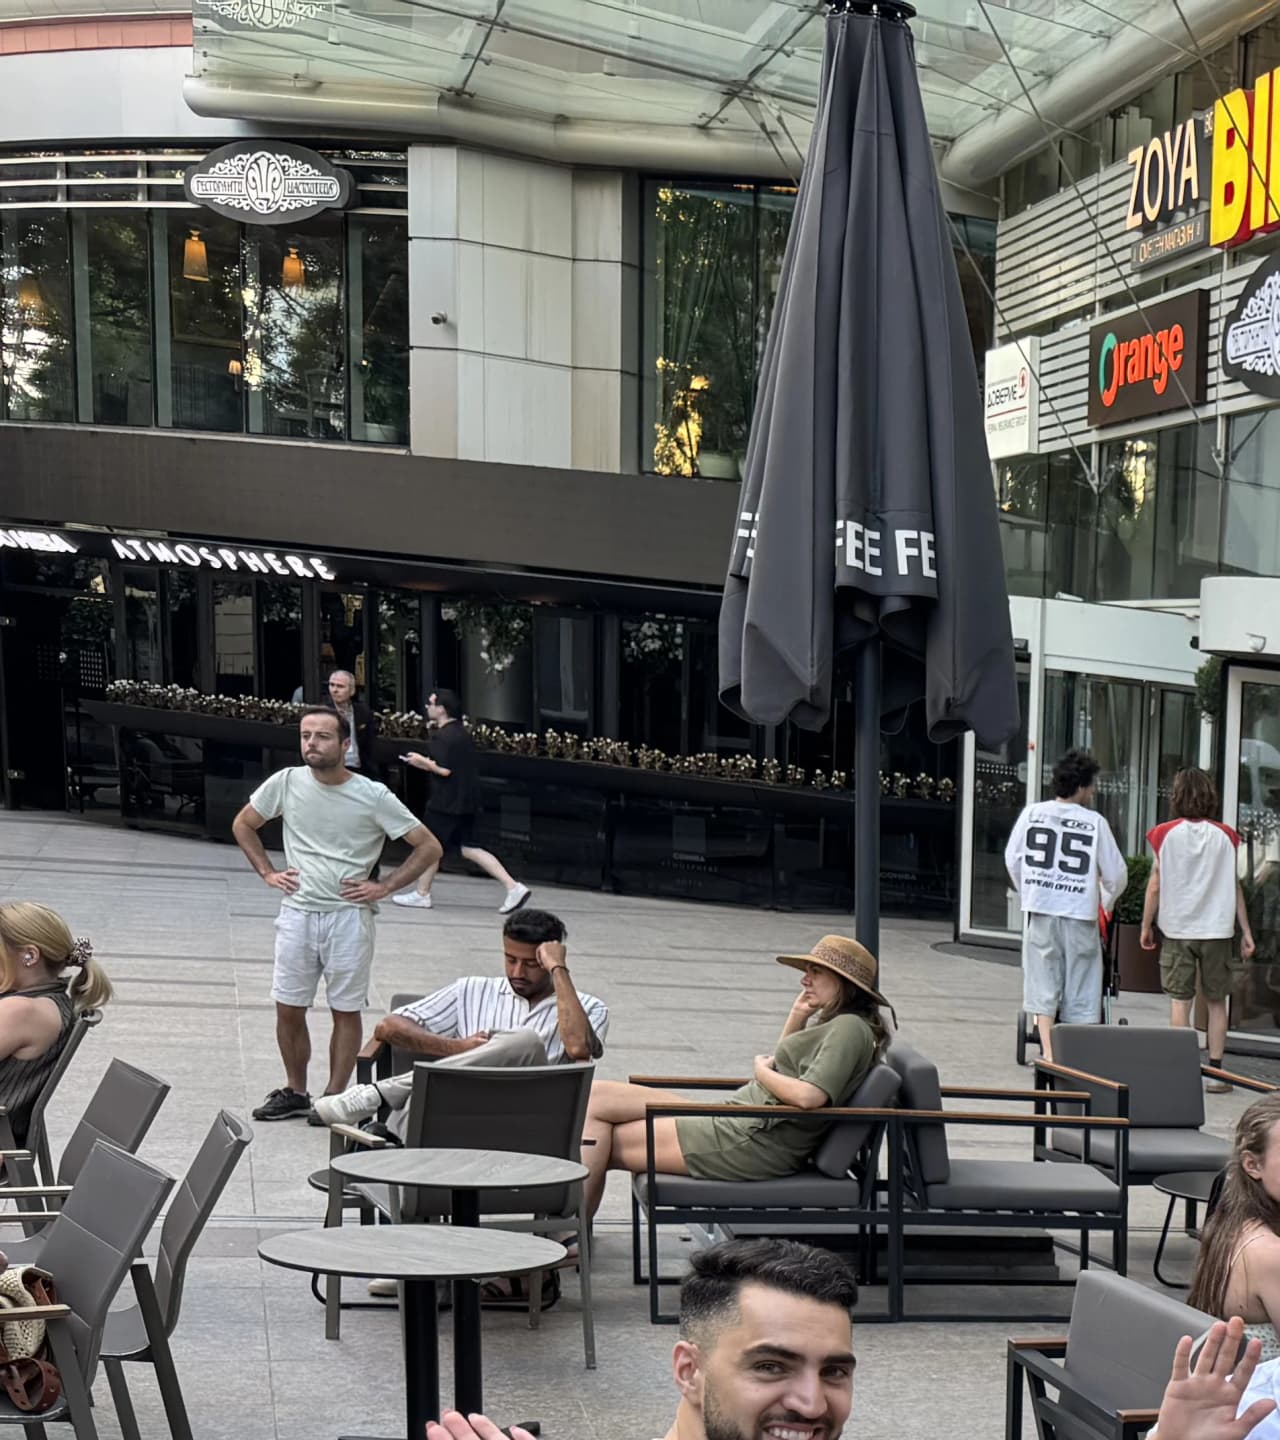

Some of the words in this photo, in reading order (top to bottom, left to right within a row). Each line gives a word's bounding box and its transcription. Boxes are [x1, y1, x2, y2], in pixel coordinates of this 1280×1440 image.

[1126, 118, 1199, 230] ZOYA
[1099, 324, 1184, 407] Orange
[111, 538, 336, 581] ATMOSPHERE
[1025, 826, 1094, 876] 95
